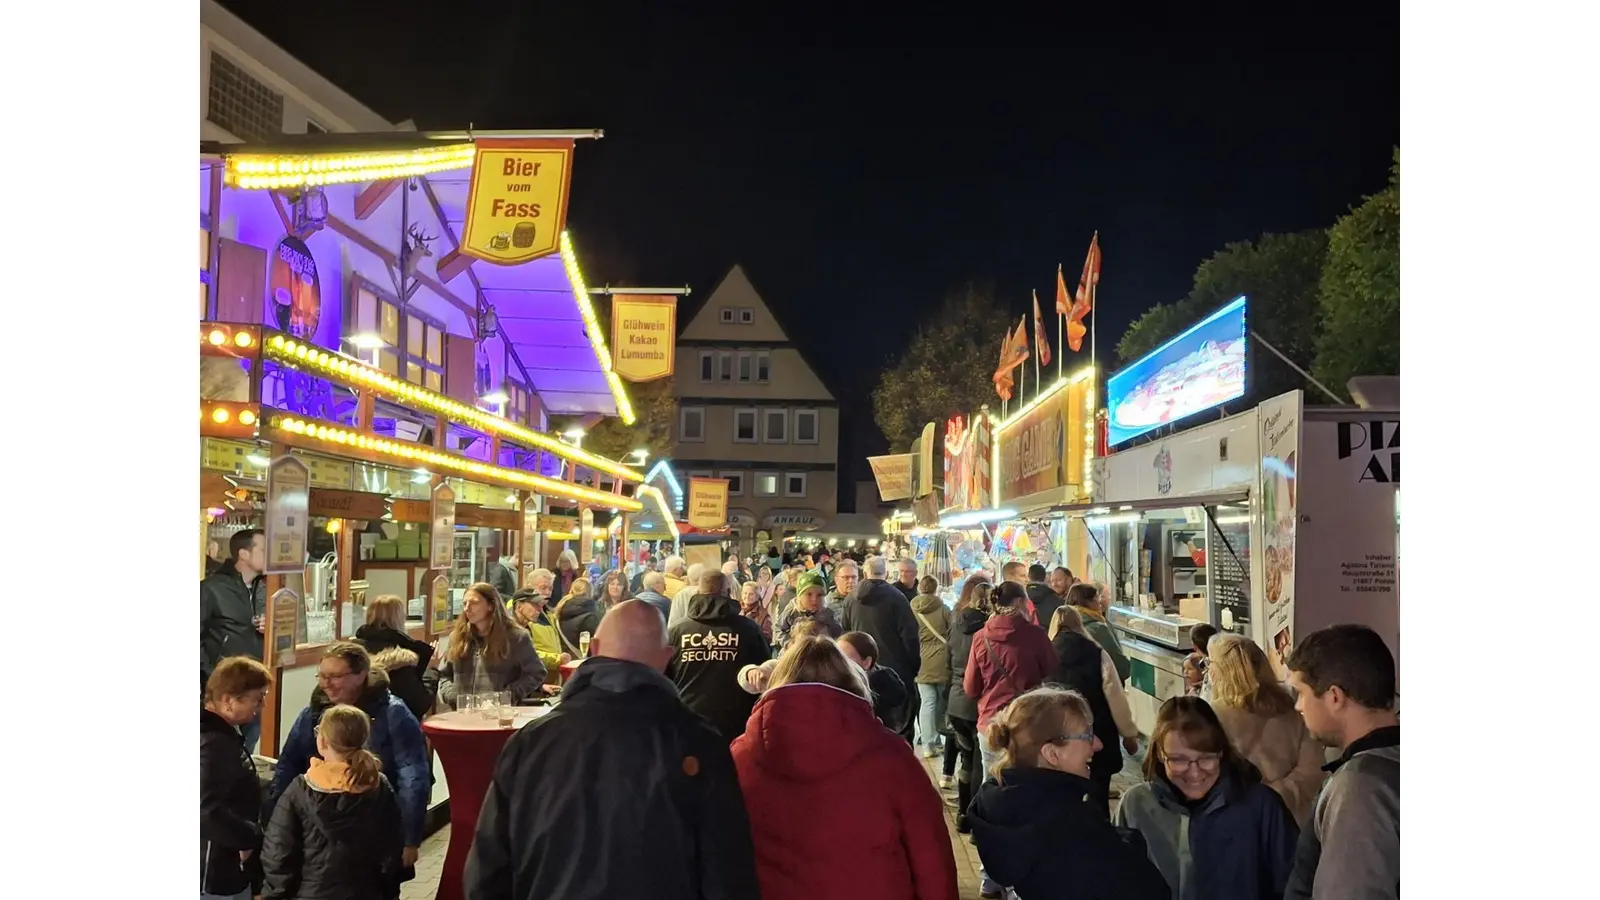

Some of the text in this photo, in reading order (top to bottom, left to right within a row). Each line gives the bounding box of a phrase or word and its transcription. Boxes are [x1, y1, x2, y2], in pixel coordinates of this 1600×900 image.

[503, 158, 541, 176] Bier
[507, 184, 531, 192] vom
[491, 199, 541, 218] Fass
[623, 319, 665, 331] Glühwein
[629, 334, 658, 345] Kakao
[621, 349, 664, 360] Lumumba
[774, 516, 815, 524] ANKAUF
[681, 650, 738, 662] SECURITY
